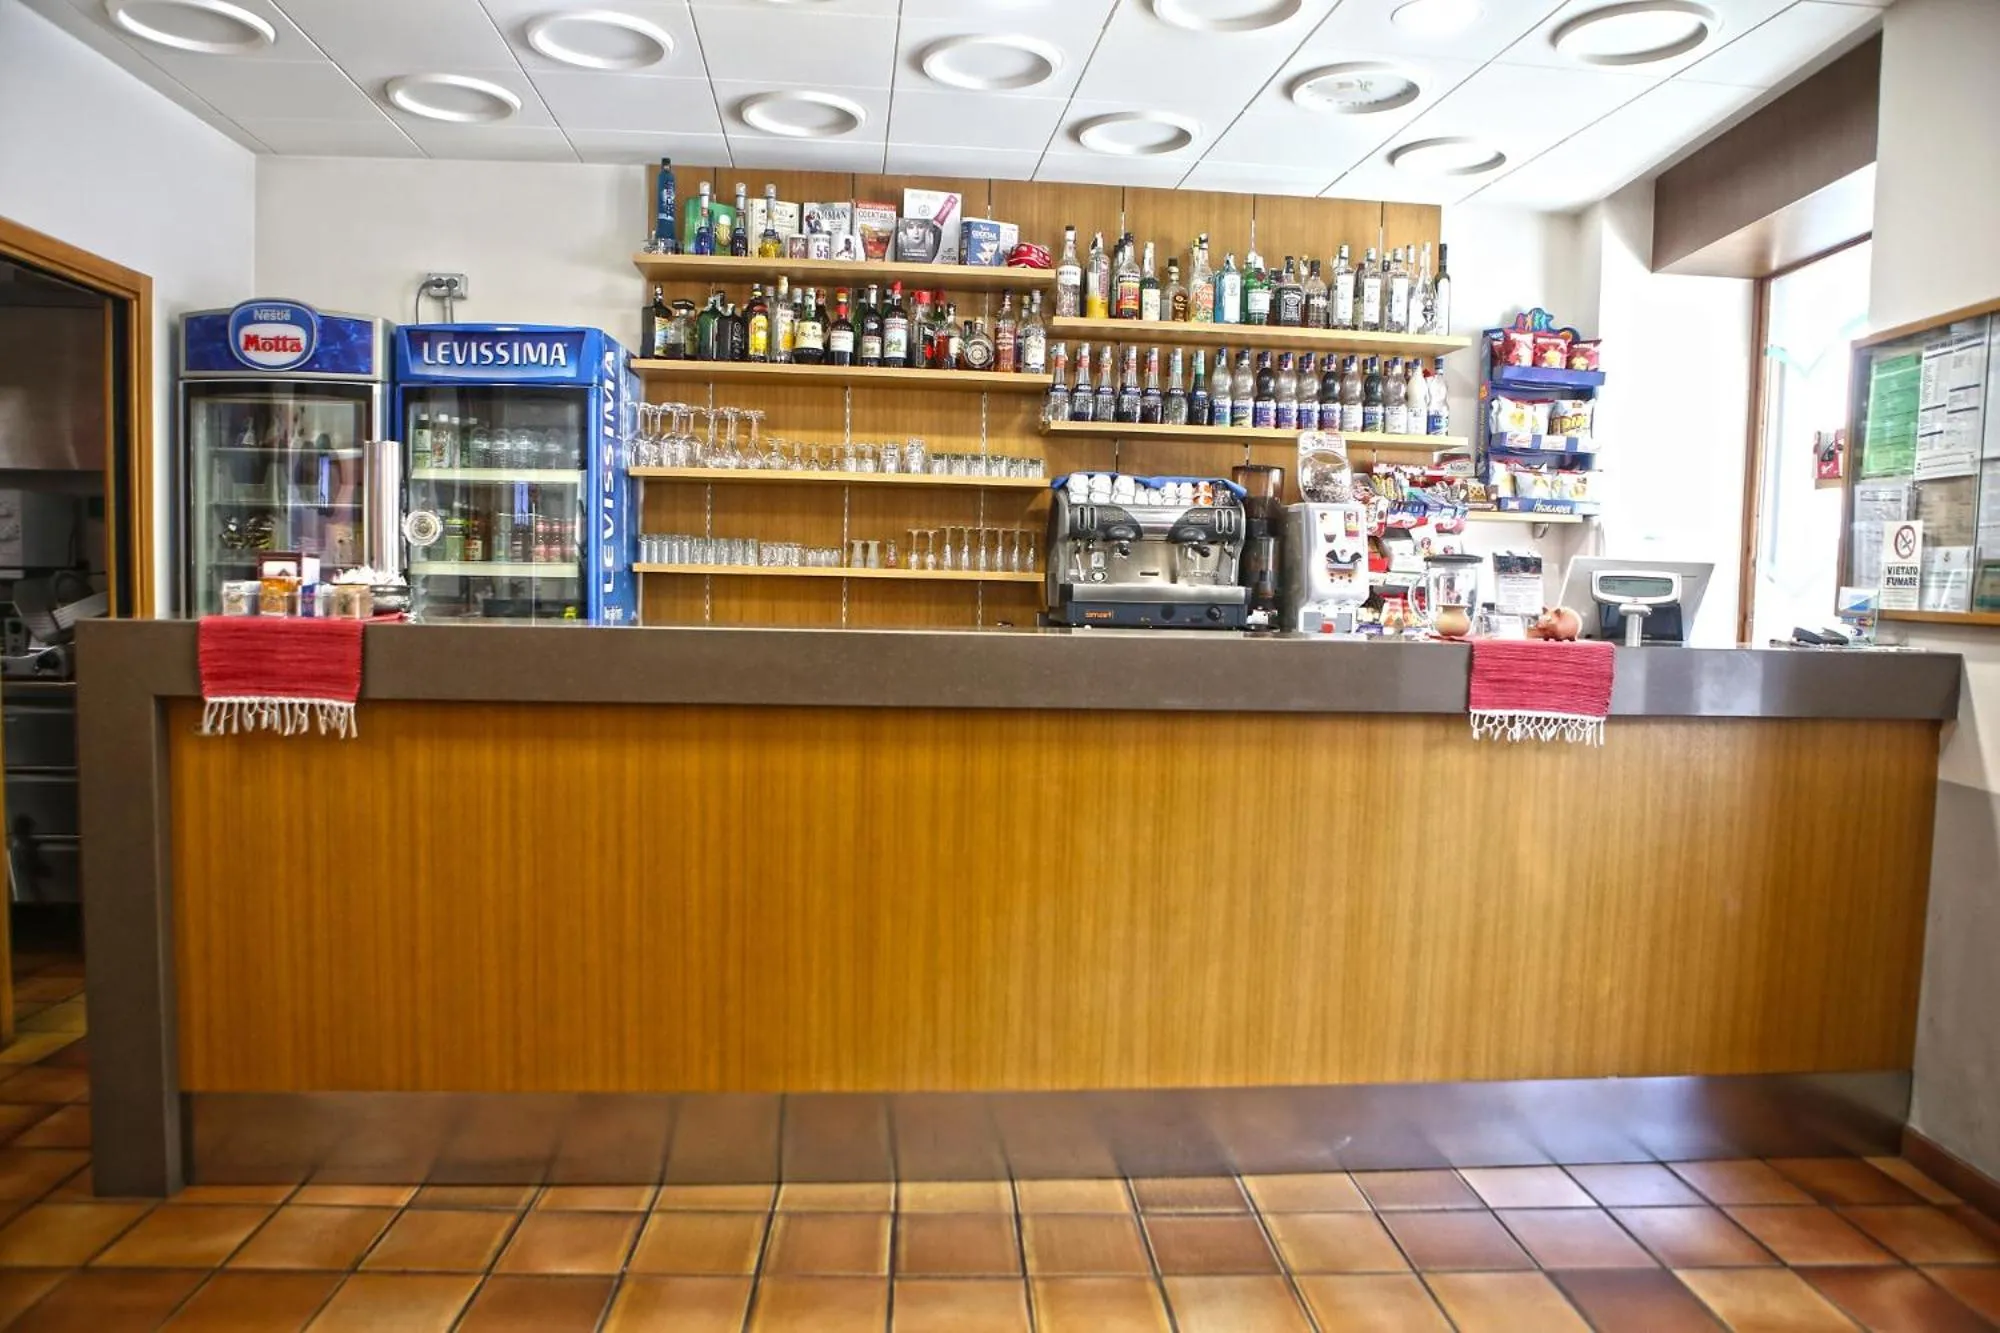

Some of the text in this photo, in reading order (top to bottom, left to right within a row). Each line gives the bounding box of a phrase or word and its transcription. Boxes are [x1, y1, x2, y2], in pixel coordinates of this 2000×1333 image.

[243, 333, 303, 352] Motta
[423, 341, 566, 366] LEVISSIMA
[603, 351, 615, 593] LEVISSIMA
[1887, 566, 1918, 575] VIETATO
[1886, 576, 1918, 587] FUMARE
